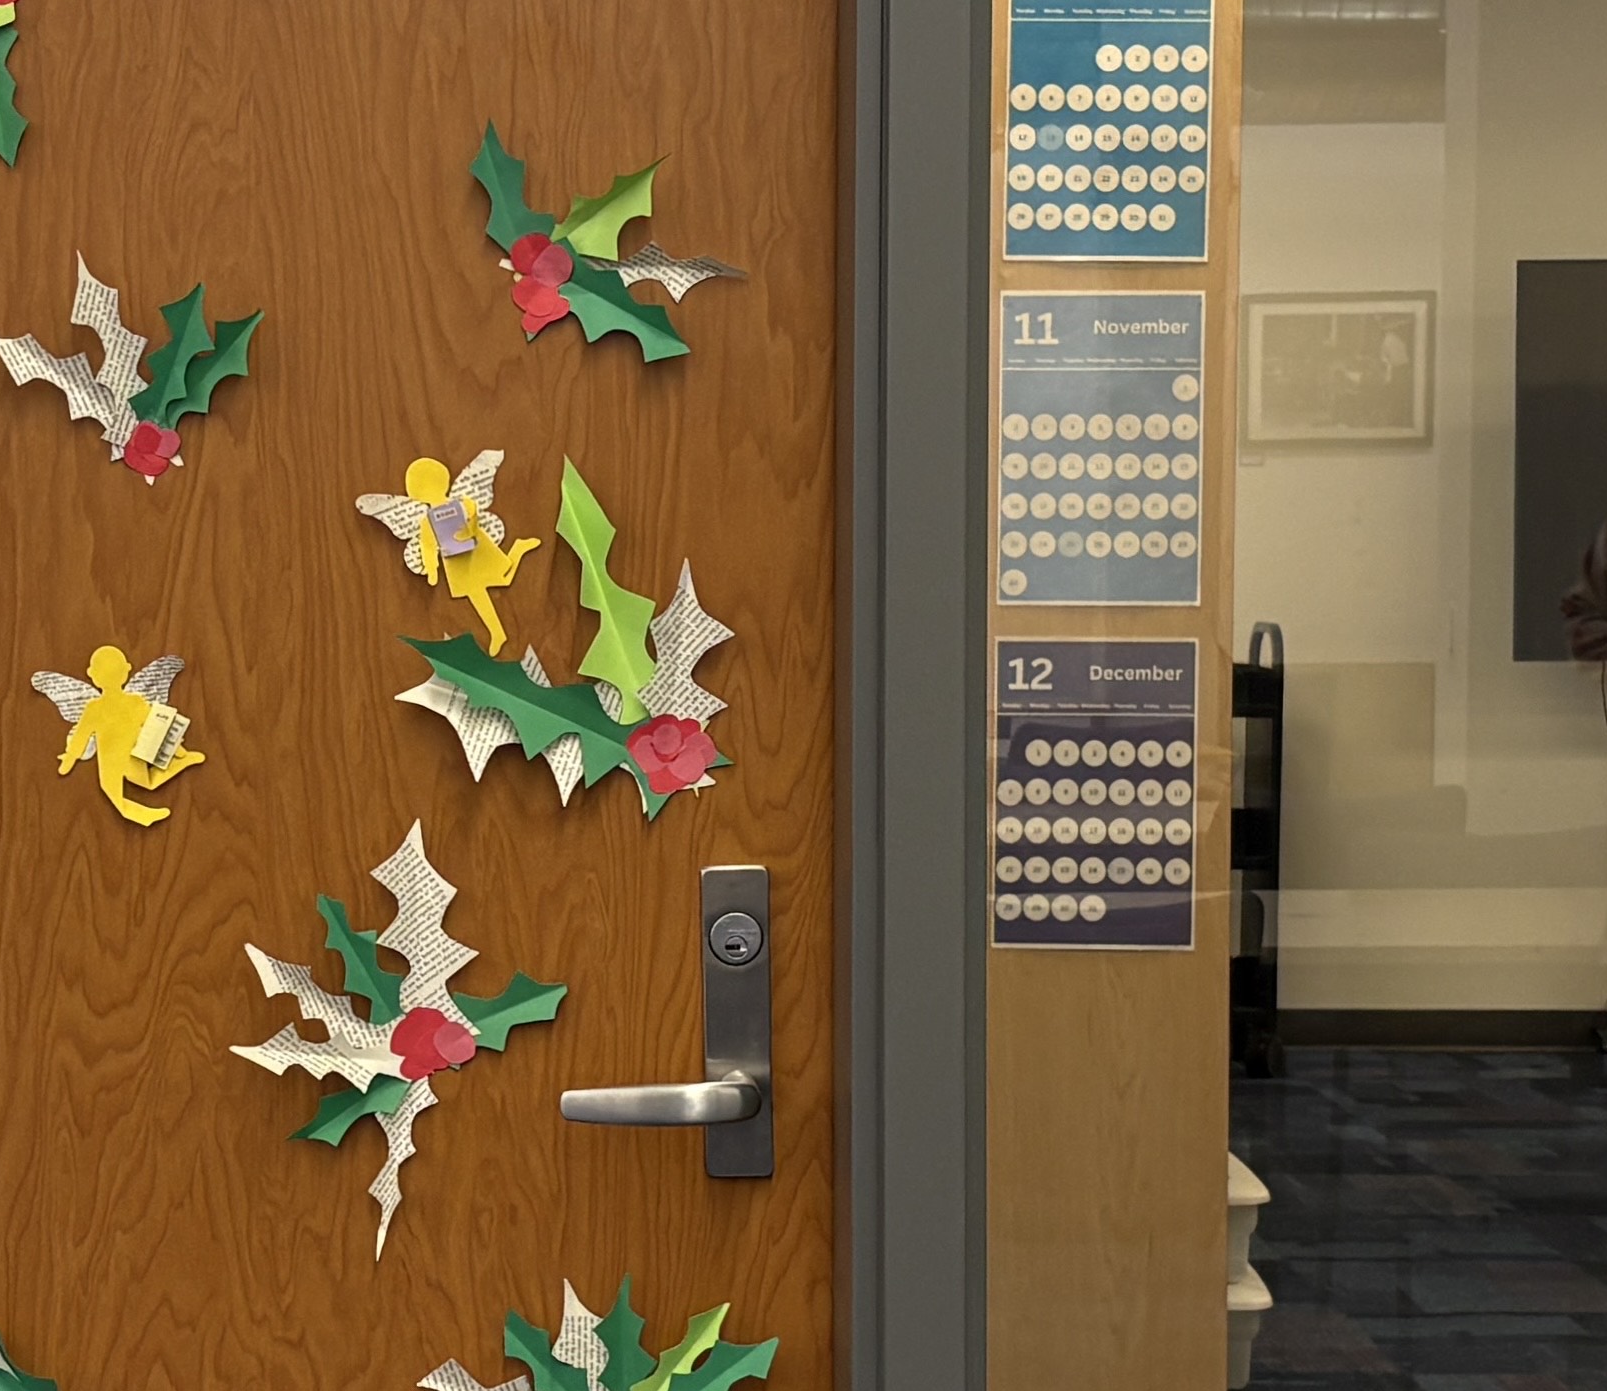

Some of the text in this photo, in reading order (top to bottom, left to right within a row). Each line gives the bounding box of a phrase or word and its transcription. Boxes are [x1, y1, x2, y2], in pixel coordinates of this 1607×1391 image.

[1013, 311, 1190, 345] 11 November
[1008, 657, 1183, 690] 12 December
